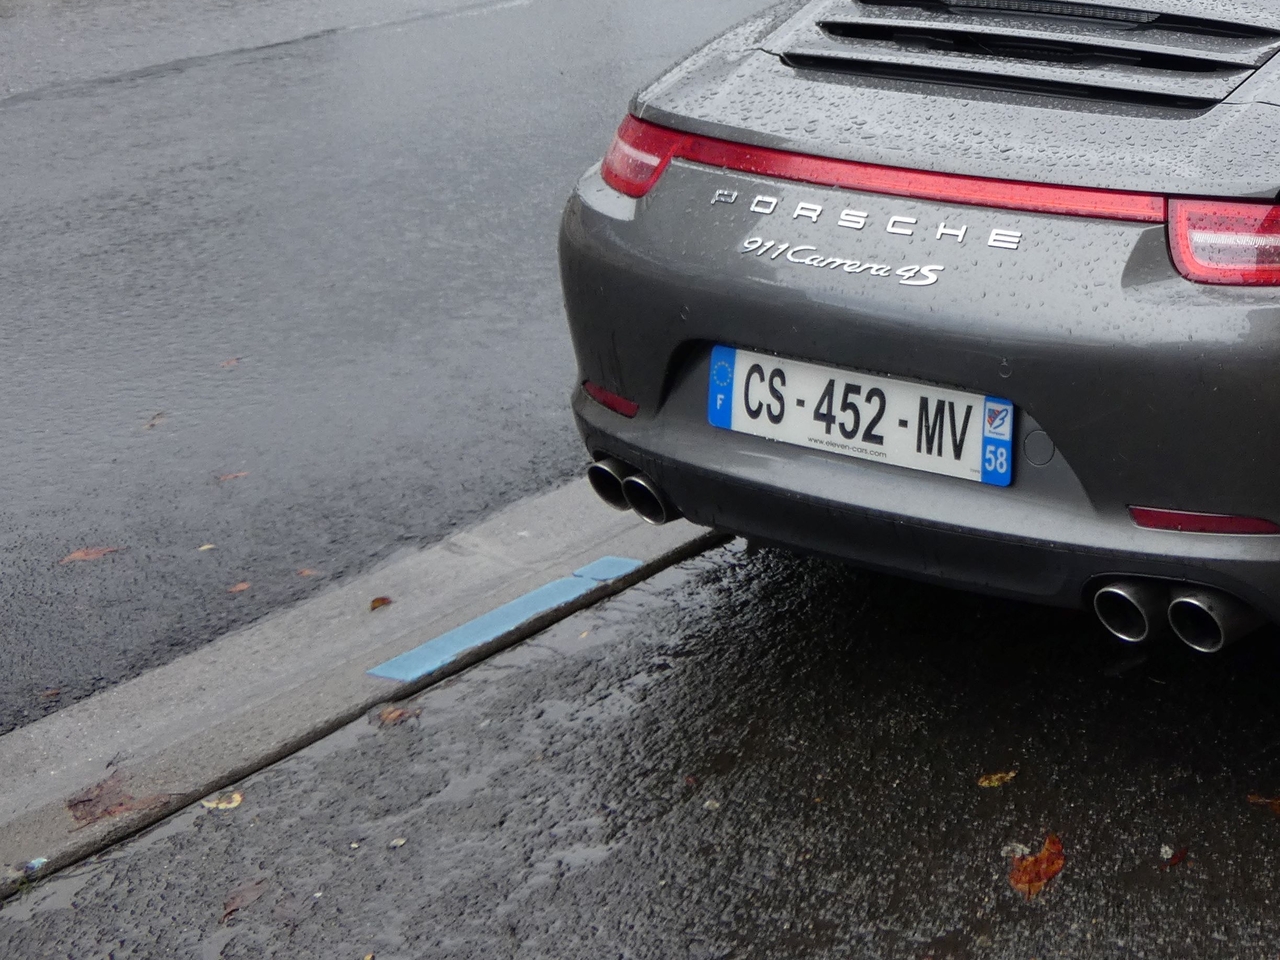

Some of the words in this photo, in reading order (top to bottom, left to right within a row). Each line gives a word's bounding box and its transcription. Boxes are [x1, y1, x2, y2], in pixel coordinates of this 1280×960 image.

[711, 189, 1023, 250] PORSCHE
[742, 237, 789, 261] 911
[786, 245, 890, 277] Carrera
[894, 265, 945, 287] 4S
[715, 394, 725, 410] F
[807, 436, 887, 458] www.eleven-cars.com
[985, 444, 1008, 474] 58
